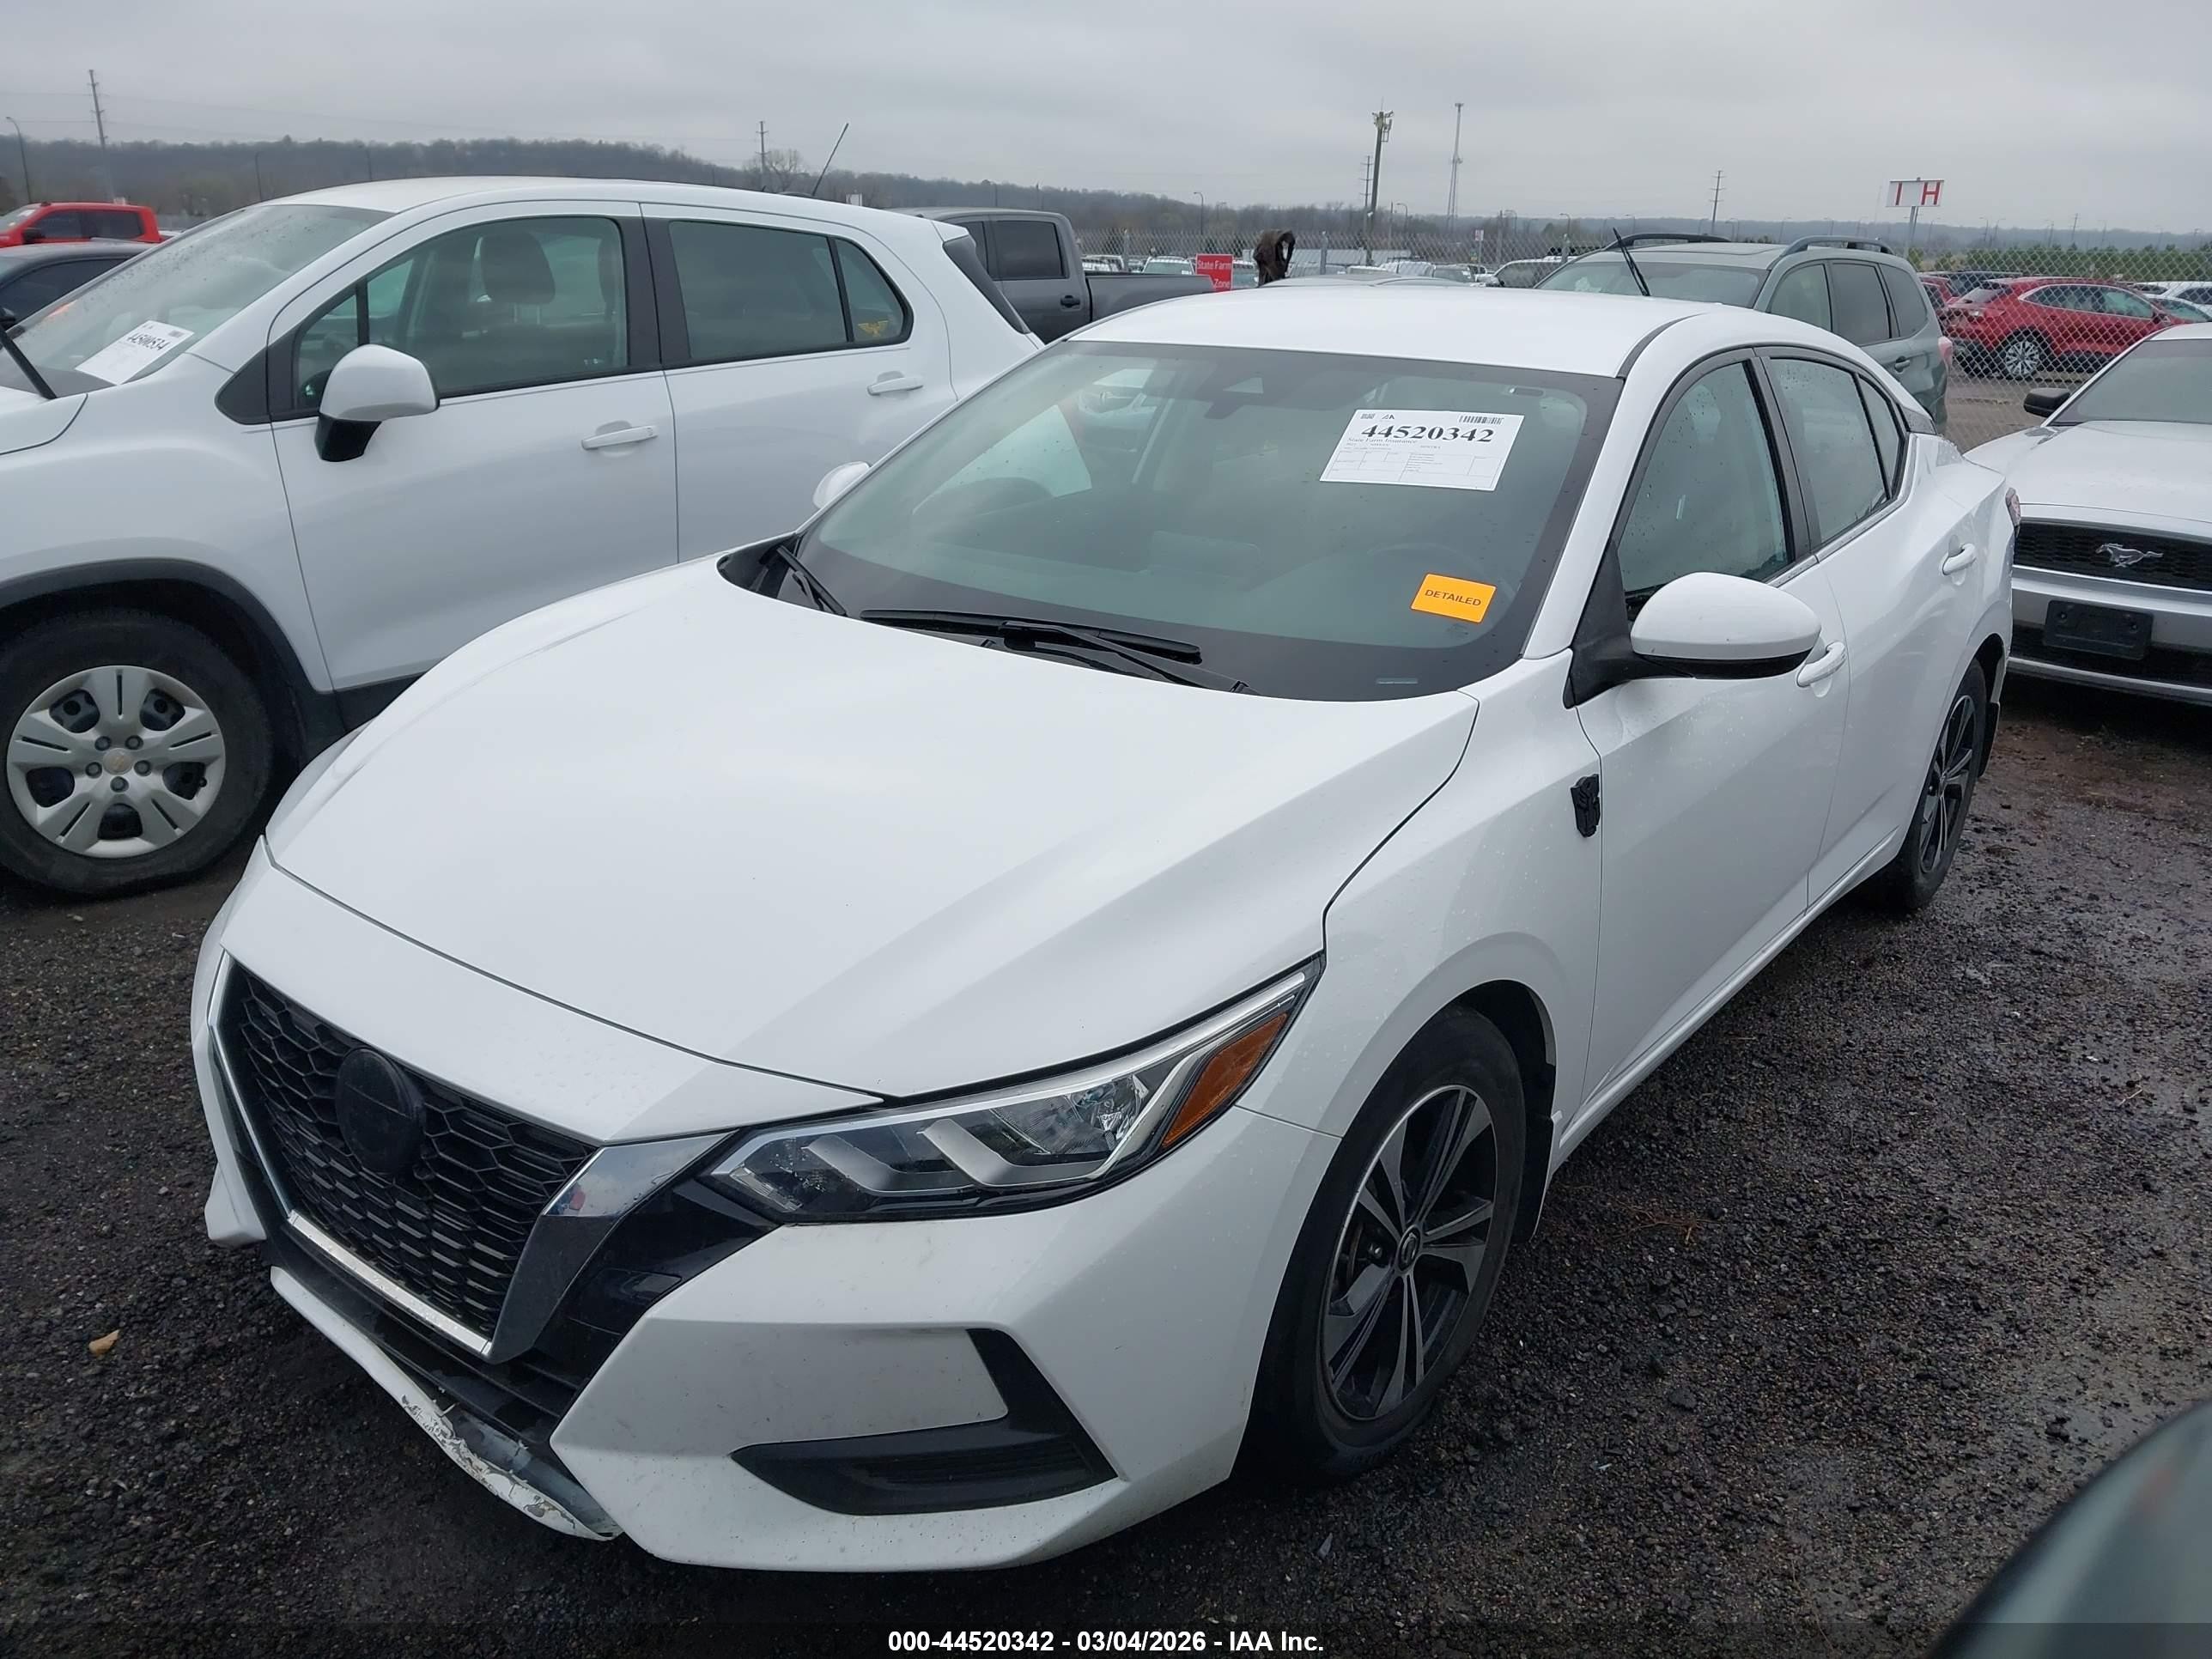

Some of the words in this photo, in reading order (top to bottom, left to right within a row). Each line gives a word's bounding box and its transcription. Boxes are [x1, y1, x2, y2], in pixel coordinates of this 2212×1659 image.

[1921, 181, 1941, 206] H
[1197, 259, 1214, 270] State
[1215, 259, 1232, 270] Farm
[1213, 278, 1231, 289] Zone
[1361, 424, 1494, 443] 44520342
[1425, 589, 1481, 606] DETAILED
